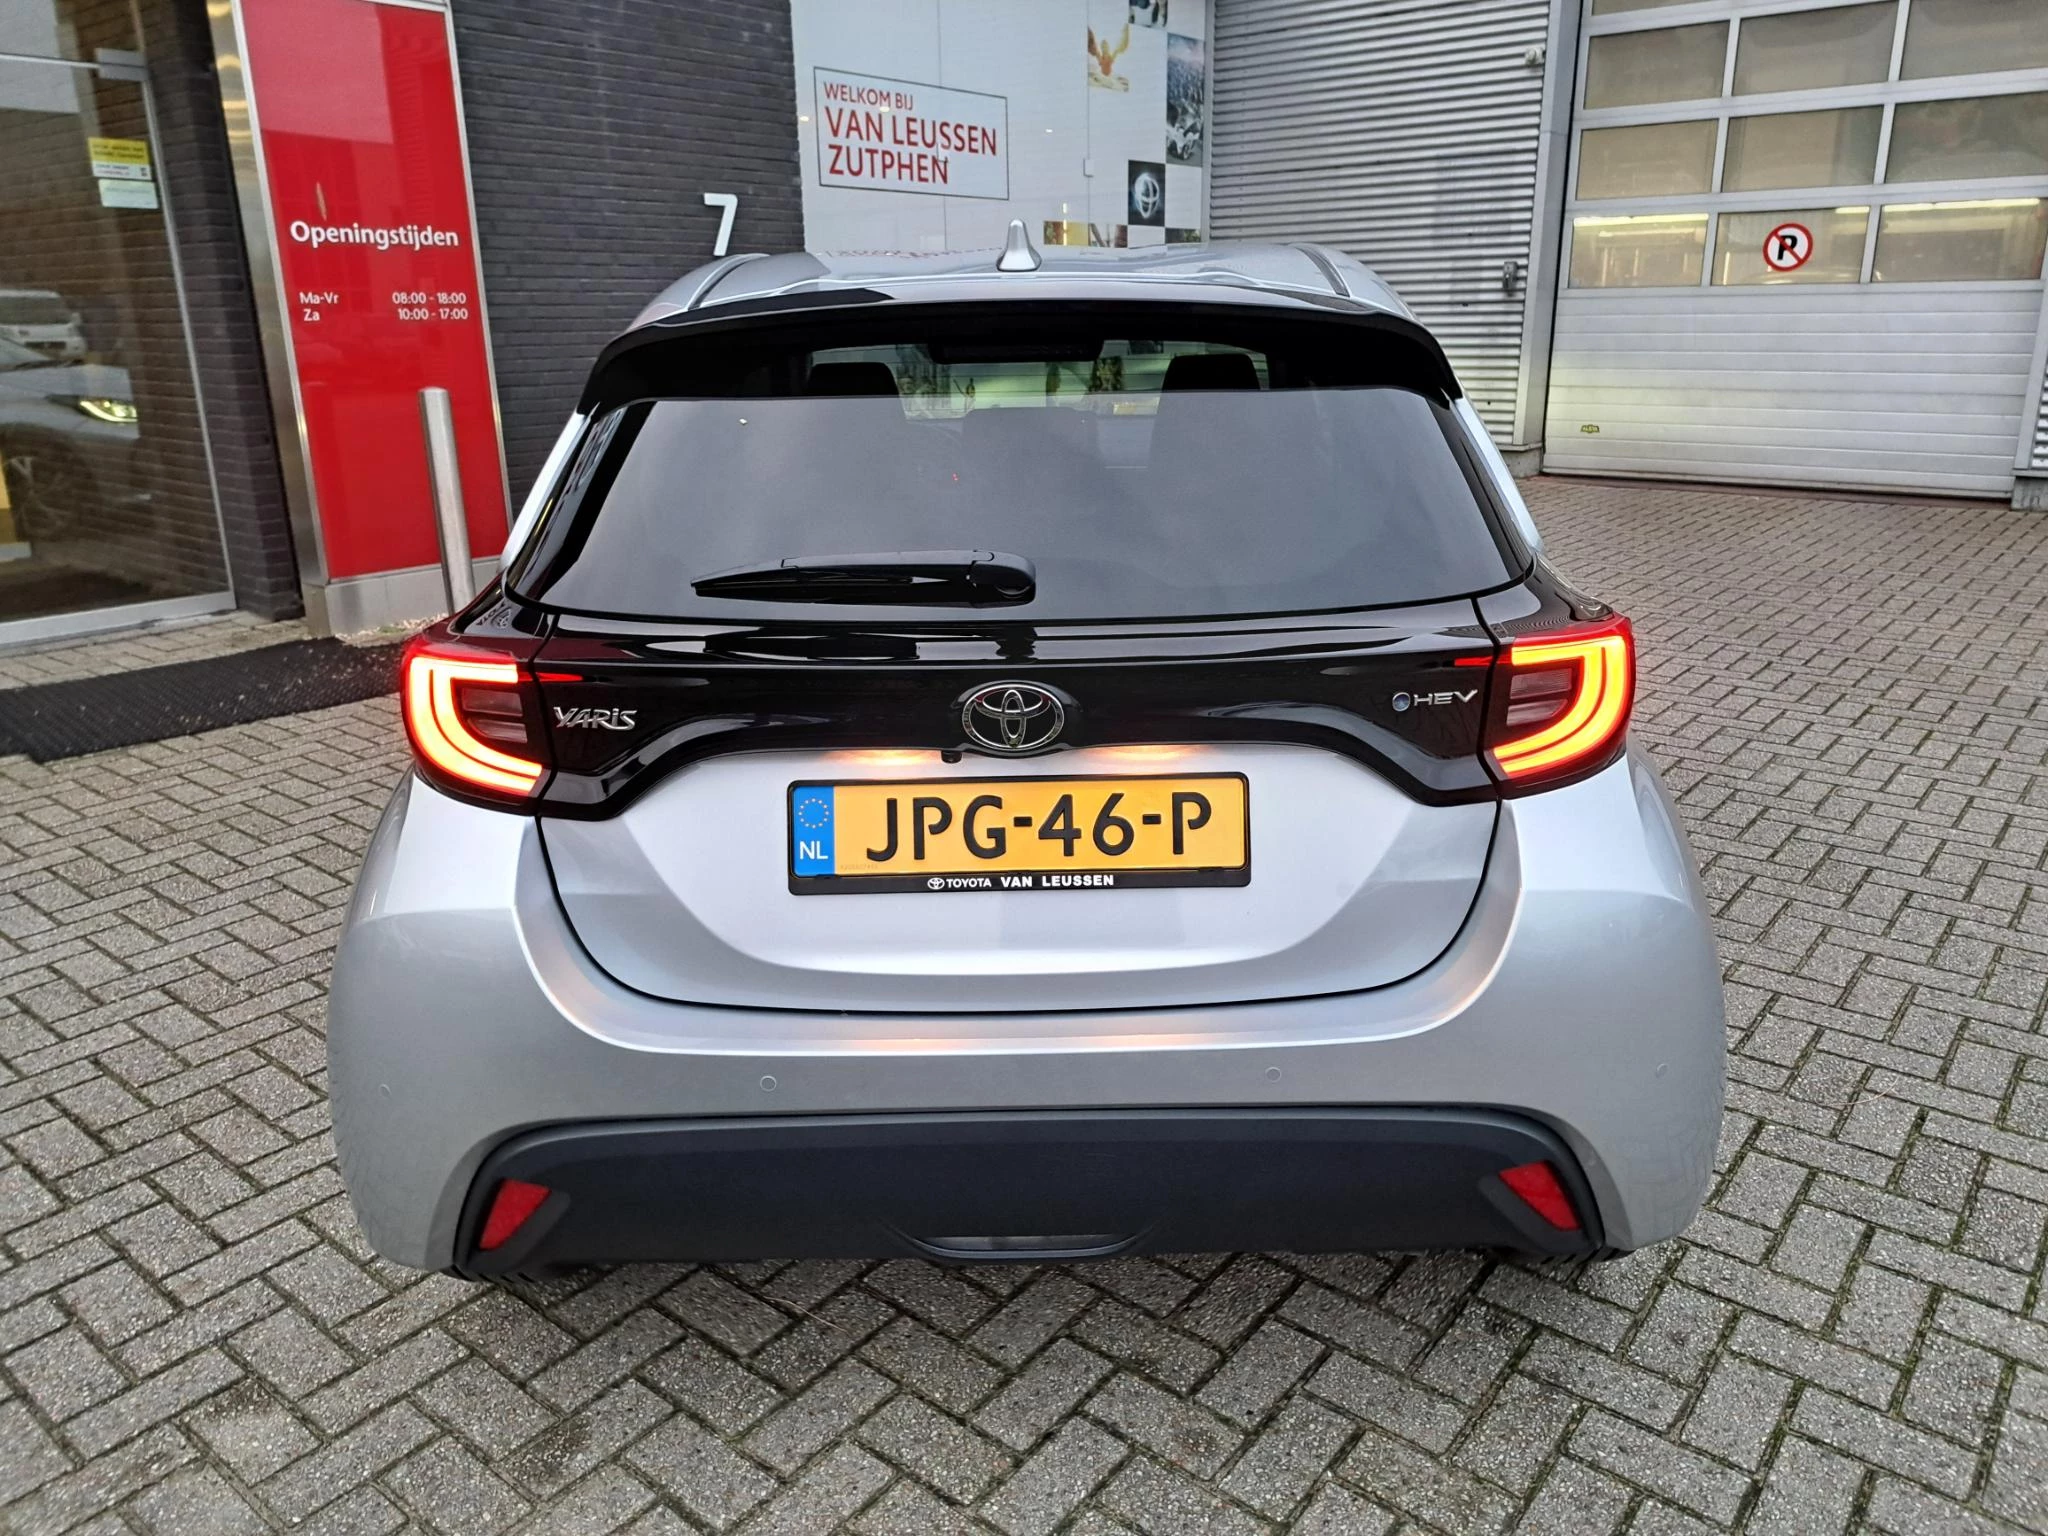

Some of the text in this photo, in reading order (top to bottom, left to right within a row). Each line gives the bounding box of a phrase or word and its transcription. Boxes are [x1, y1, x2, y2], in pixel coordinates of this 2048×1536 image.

[824, 82, 914, 111] WELKOM BIJ
[825, 106, 997, 156] VAN LEUSSEN
[828, 144, 948, 184] ZUTPHEN
[290, 221, 459, 251] Openingstijden
[704, 192, 738, 256] 7
[300, 292, 338, 304] Ma-Vr
[392, 292, 427, 304] 08:00
[437, 292, 467, 304] 18:00
[303, 308, 320, 321] Za
[398, 308, 428, 320] 10:00
[439, 308, 468, 320] 17:00
[1413, 689, 1478, 706] HEV
[866, 792, 1212, 862] JPG-46-P
[799, 841, 828, 860] NL
[946, 874, 1114, 888] TOYOTA VAN LEUSSEN
